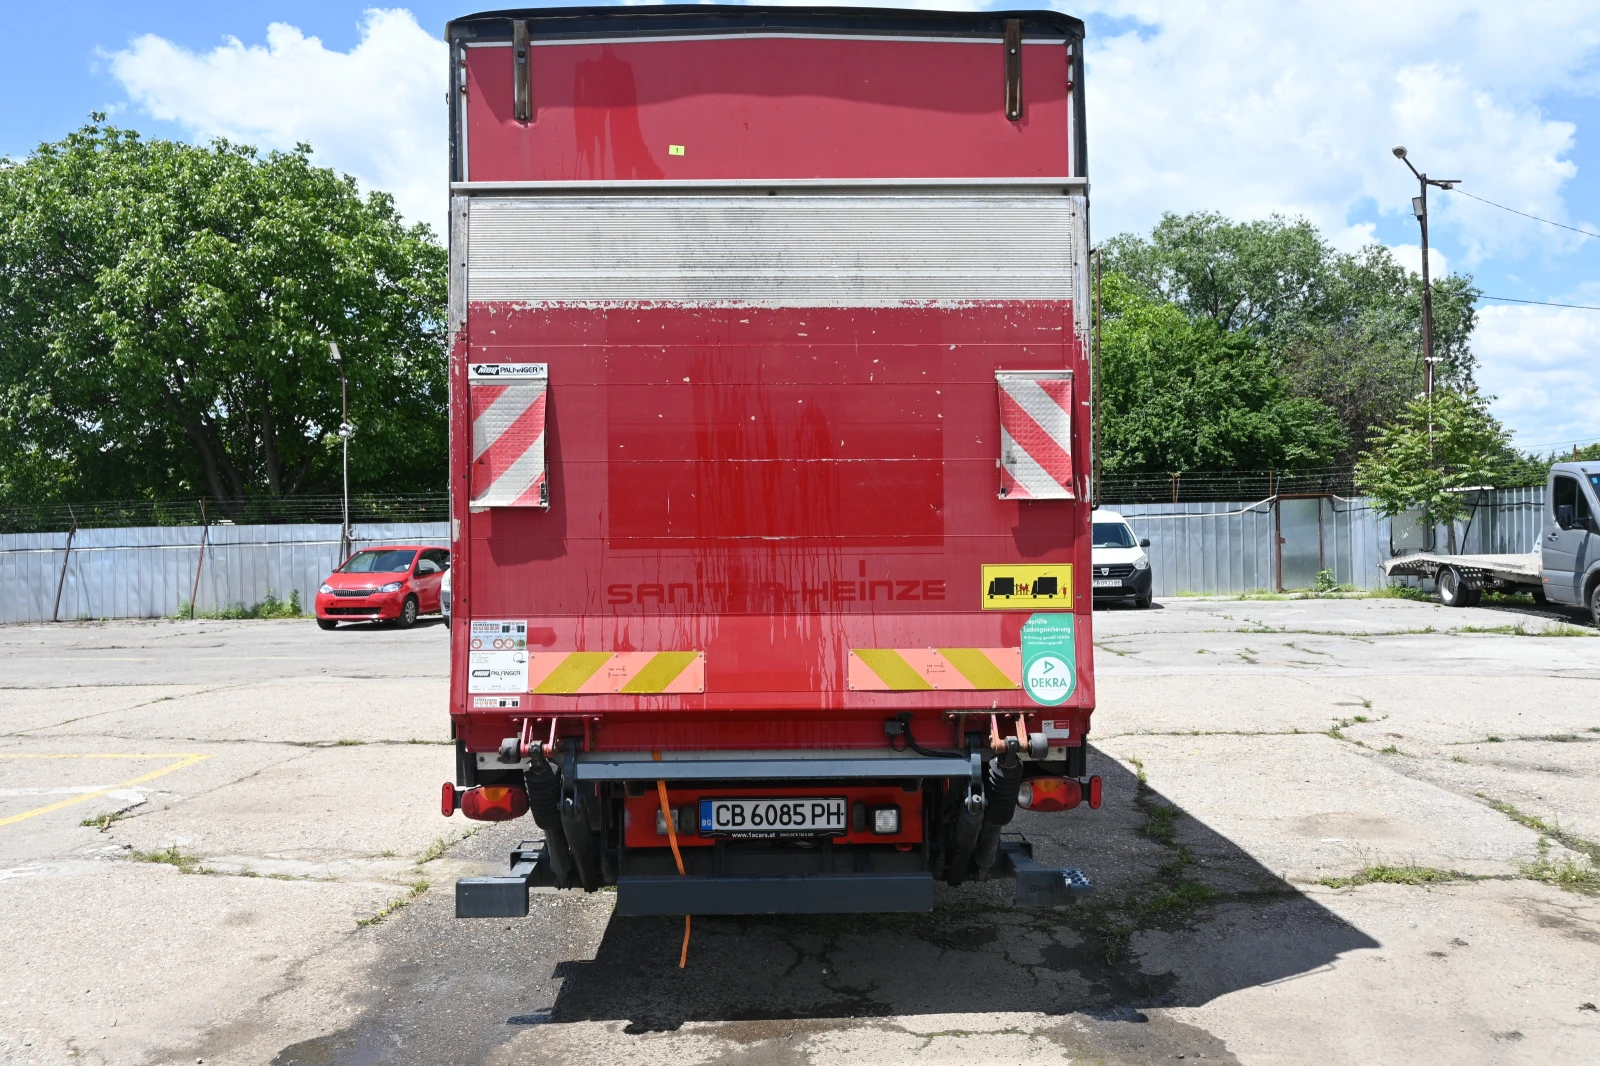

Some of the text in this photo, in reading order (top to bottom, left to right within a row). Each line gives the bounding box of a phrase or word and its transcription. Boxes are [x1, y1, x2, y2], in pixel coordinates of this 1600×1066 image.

[1023, 625, 1071, 633] Ladungssicherung
[1031, 677, 1067, 688] DEKRA
[716, 803, 841, 826] CB 6085 PH
